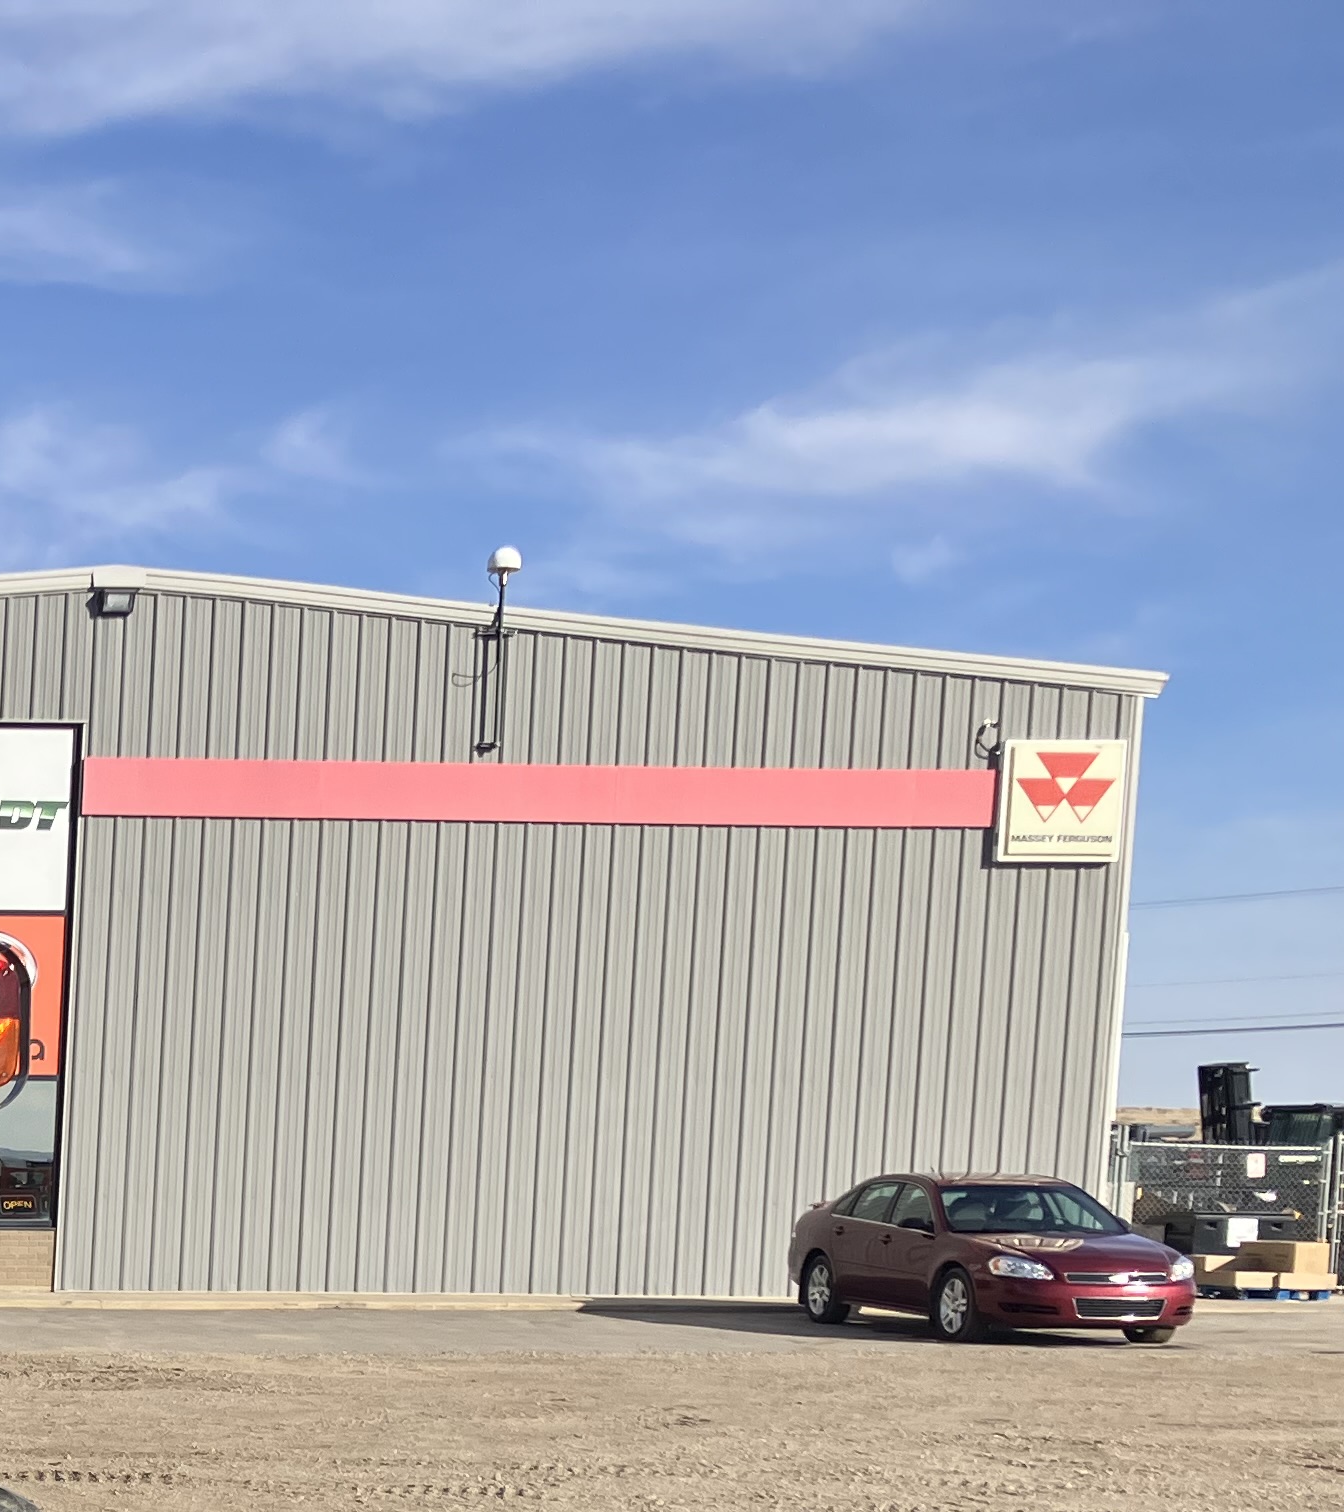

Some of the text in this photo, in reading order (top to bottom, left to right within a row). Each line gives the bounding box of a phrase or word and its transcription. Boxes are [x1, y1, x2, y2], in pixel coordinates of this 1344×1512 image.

[1011, 834, 1113, 843] MASSEY FERGUSON
[3, 1200, 33, 1210] OPEN
